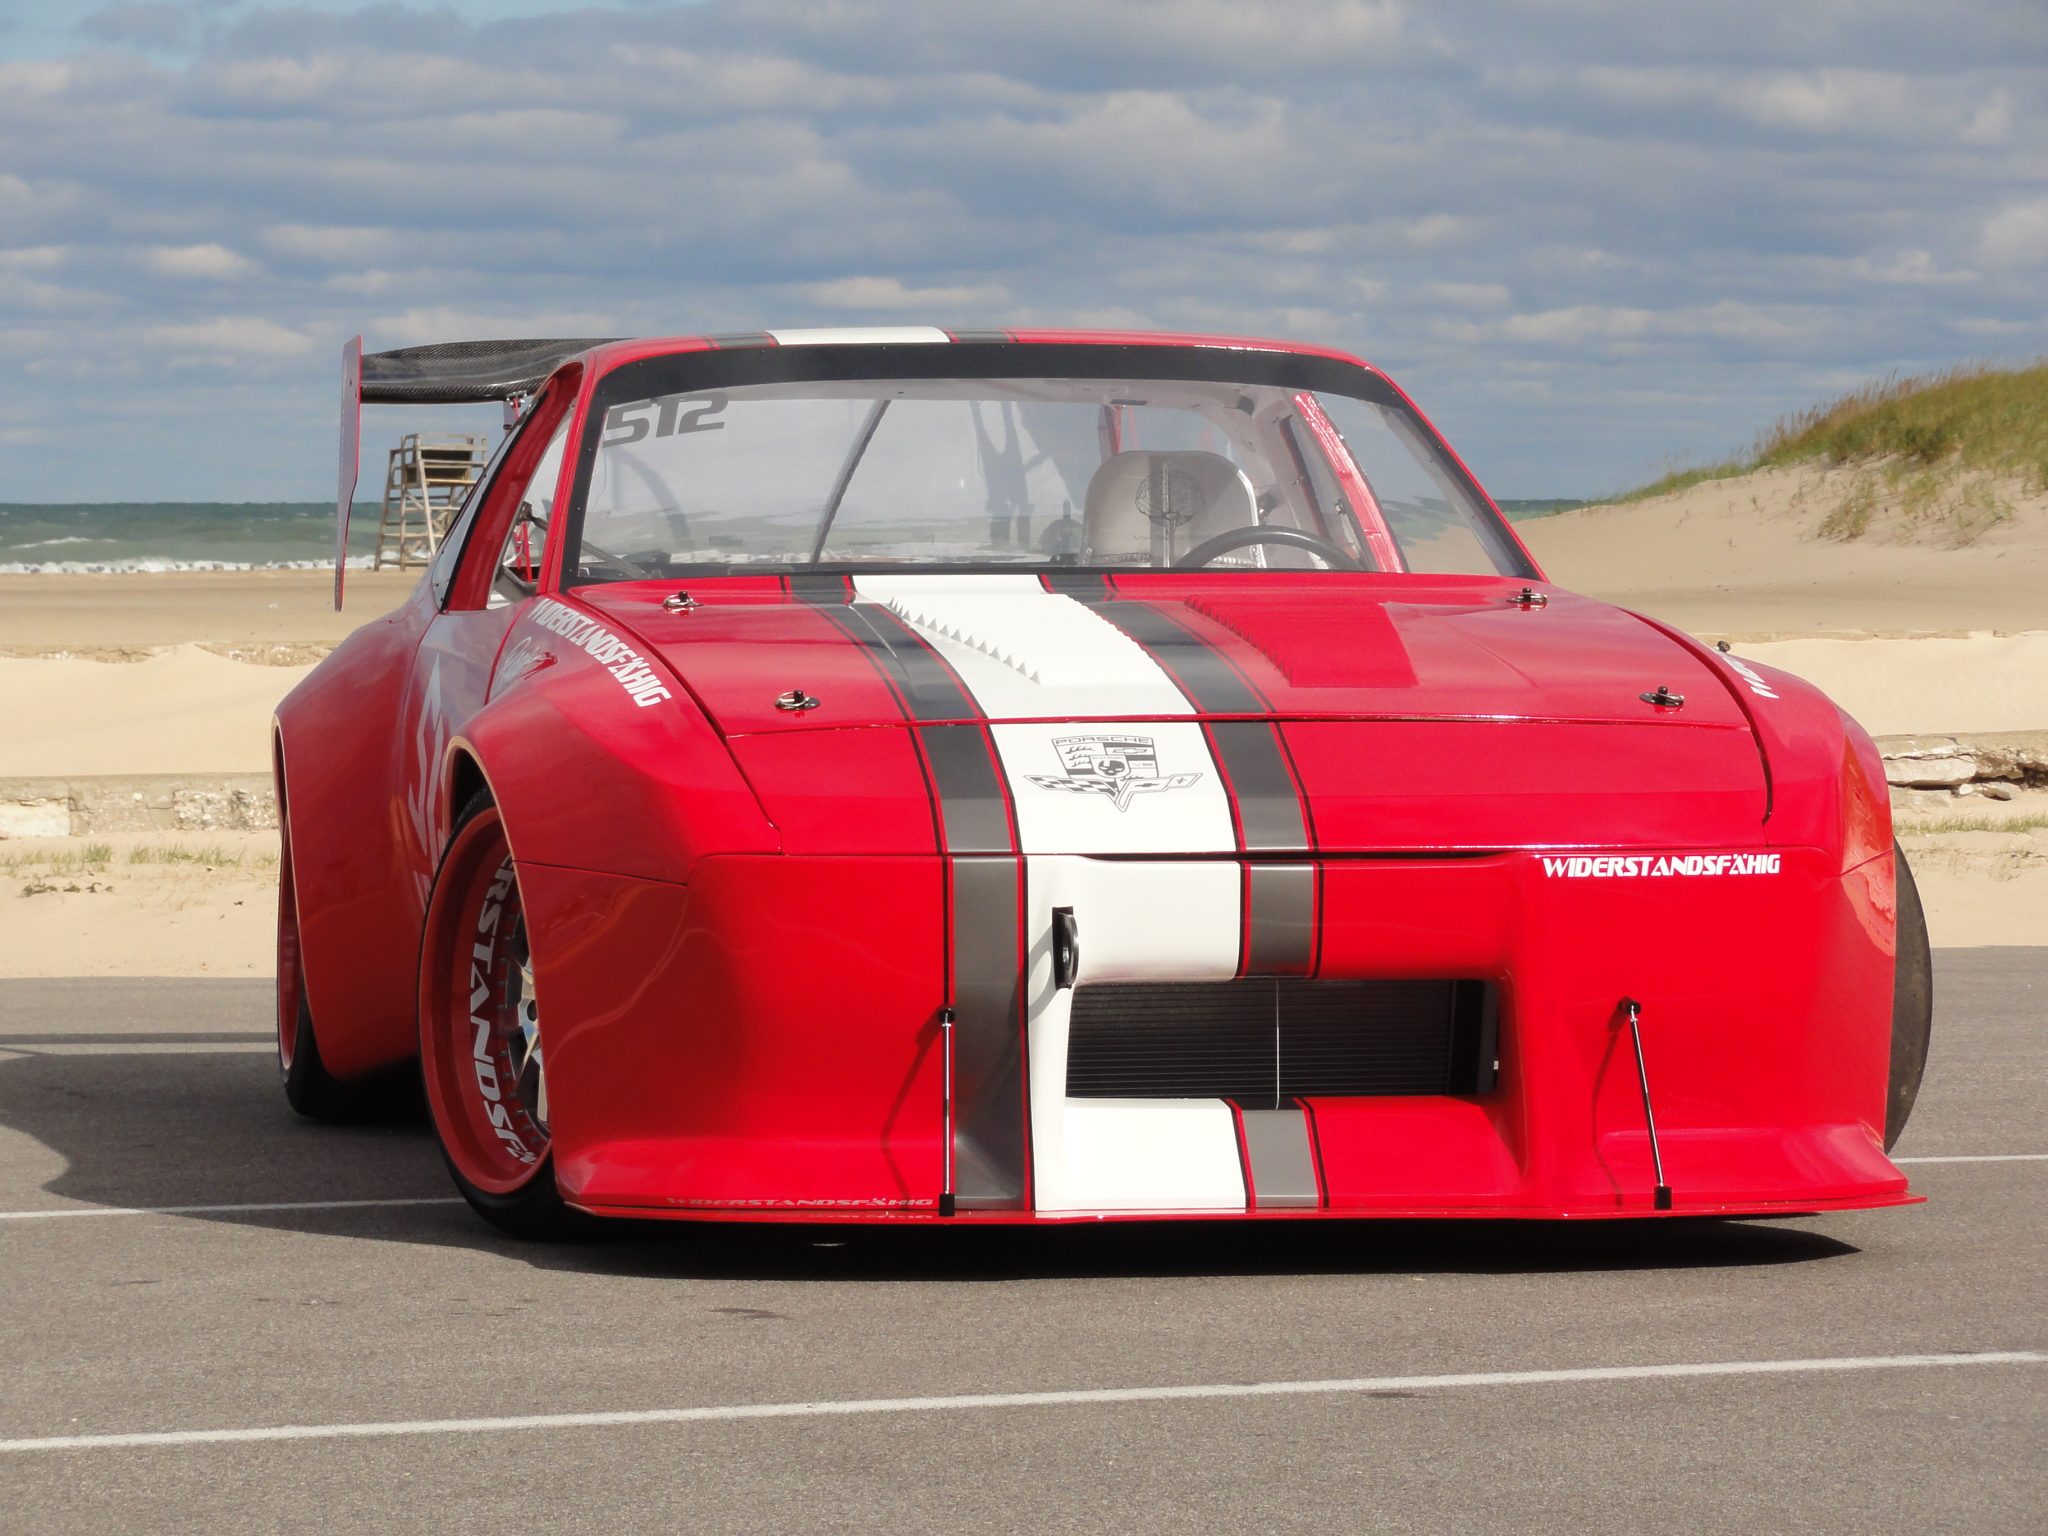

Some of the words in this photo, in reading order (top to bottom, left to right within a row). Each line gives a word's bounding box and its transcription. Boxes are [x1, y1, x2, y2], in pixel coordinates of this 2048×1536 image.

[602, 391, 728, 448] 512
[1056, 736, 1150, 745] PORSCHE
[1542, 854, 1780, 877] WIDERSTANDSFÄHIG
